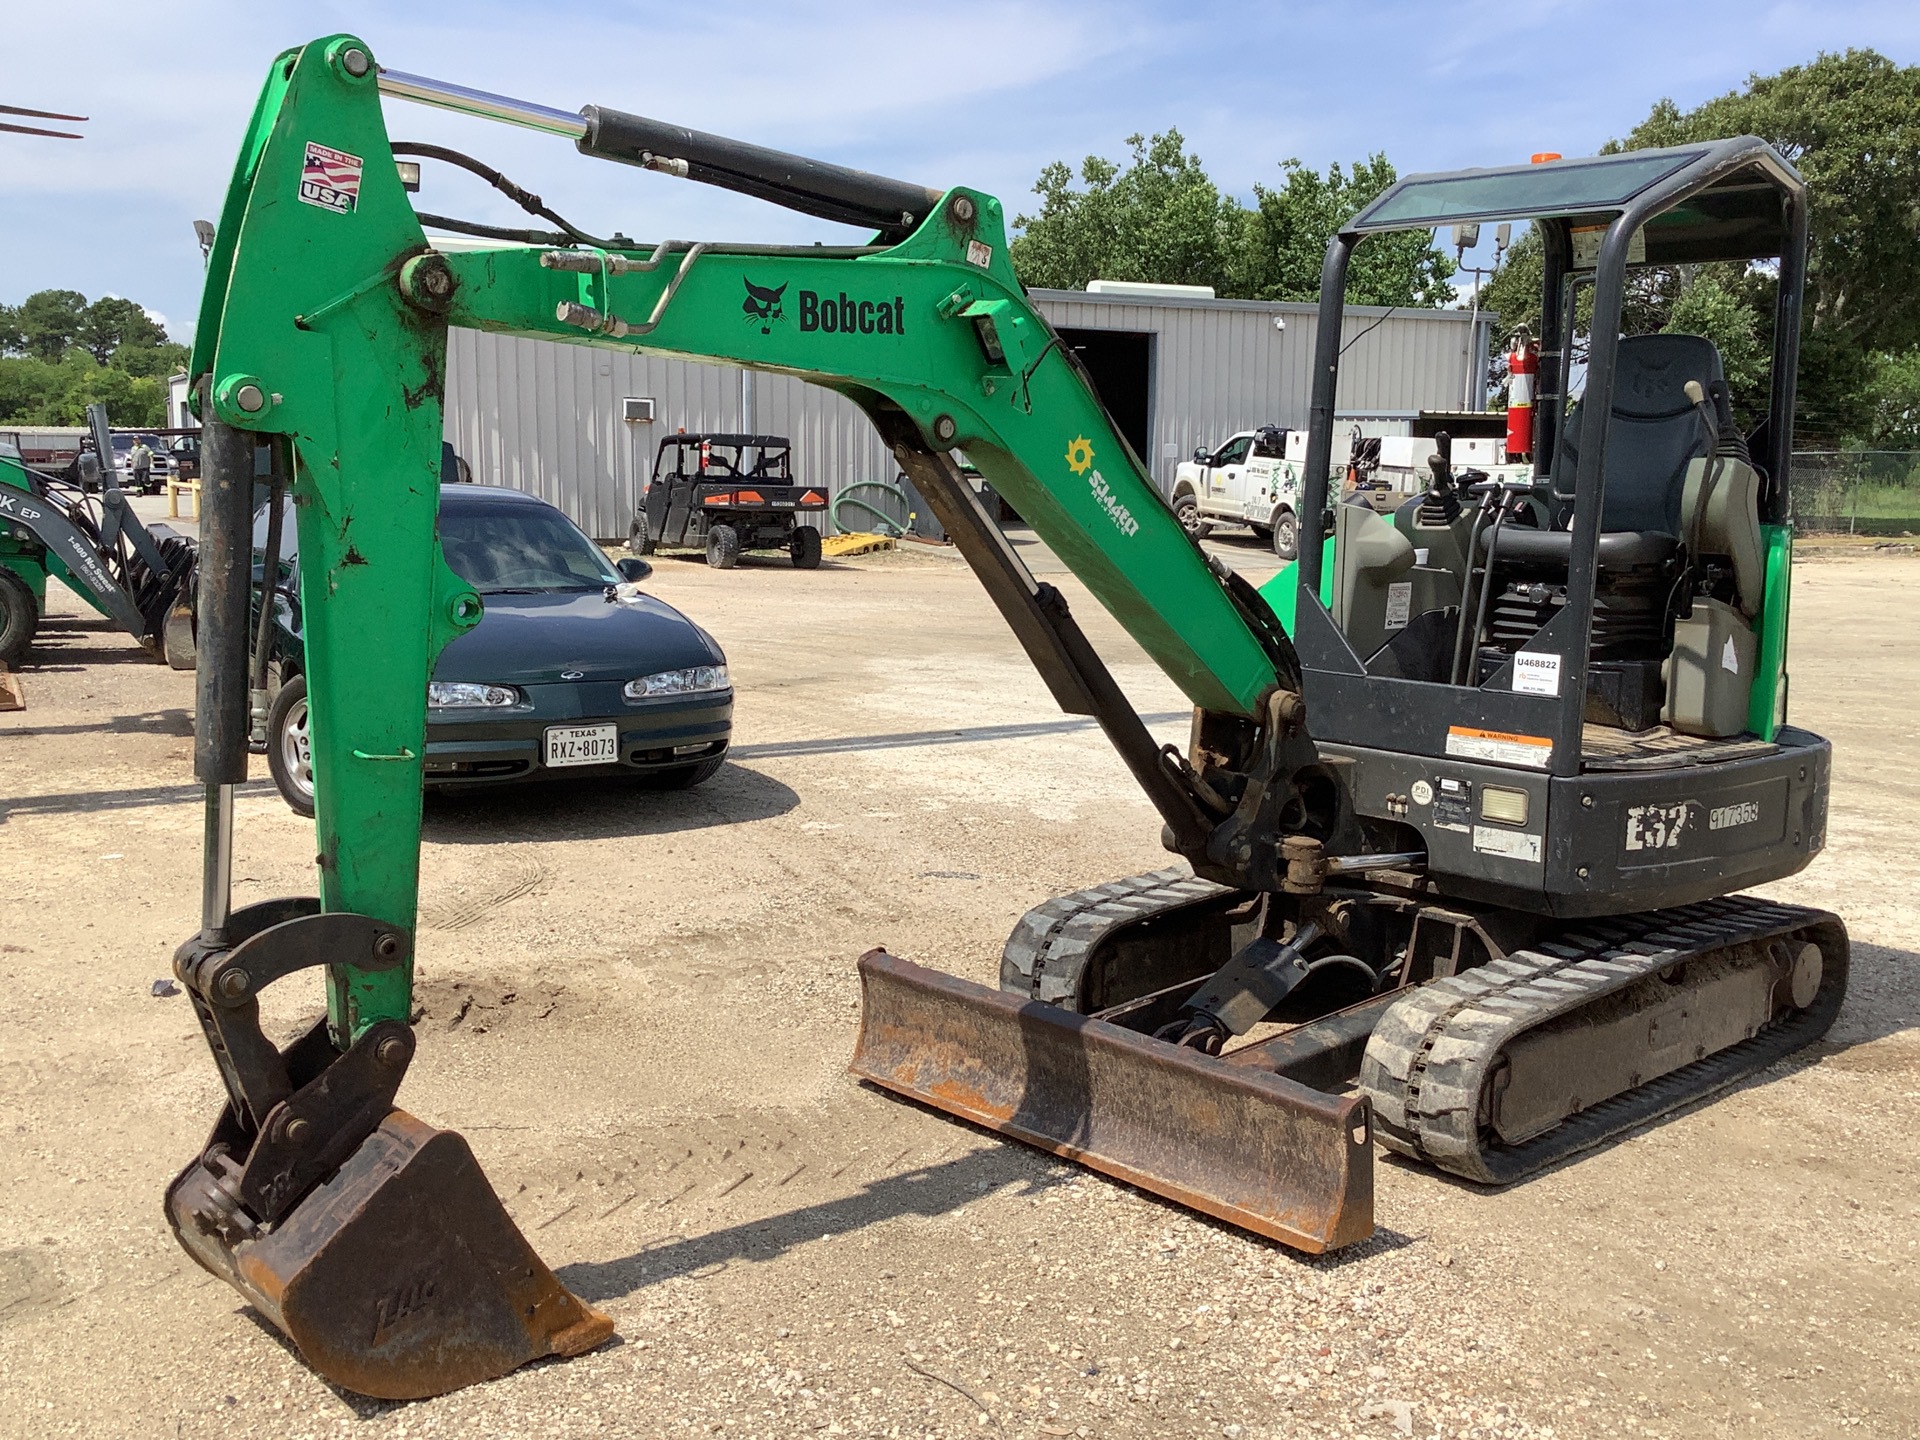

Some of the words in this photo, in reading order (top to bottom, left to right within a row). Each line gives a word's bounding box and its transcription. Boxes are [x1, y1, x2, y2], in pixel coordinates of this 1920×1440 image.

[309, 145, 333, 159] MADE
[334, 153, 343, 162] IN
[344, 157, 359, 167] THE
[303, 182, 351, 208] USA
[799, 290, 905, 335] Bobcat
[20, 507, 41, 520] EP
[1090, 489, 1126, 536] RENTALS
[67, 535, 88, 558] 1-800
[84, 556, 96, 570] No
[1517, 658, 1557, 670] U468822
[569, 729, 597, 738] TEXAS
[1487, 732, 1520, 742] WARNING
[1415, 785, 1430, 795] PDI
[1626, 801, 1688, 850] E32
